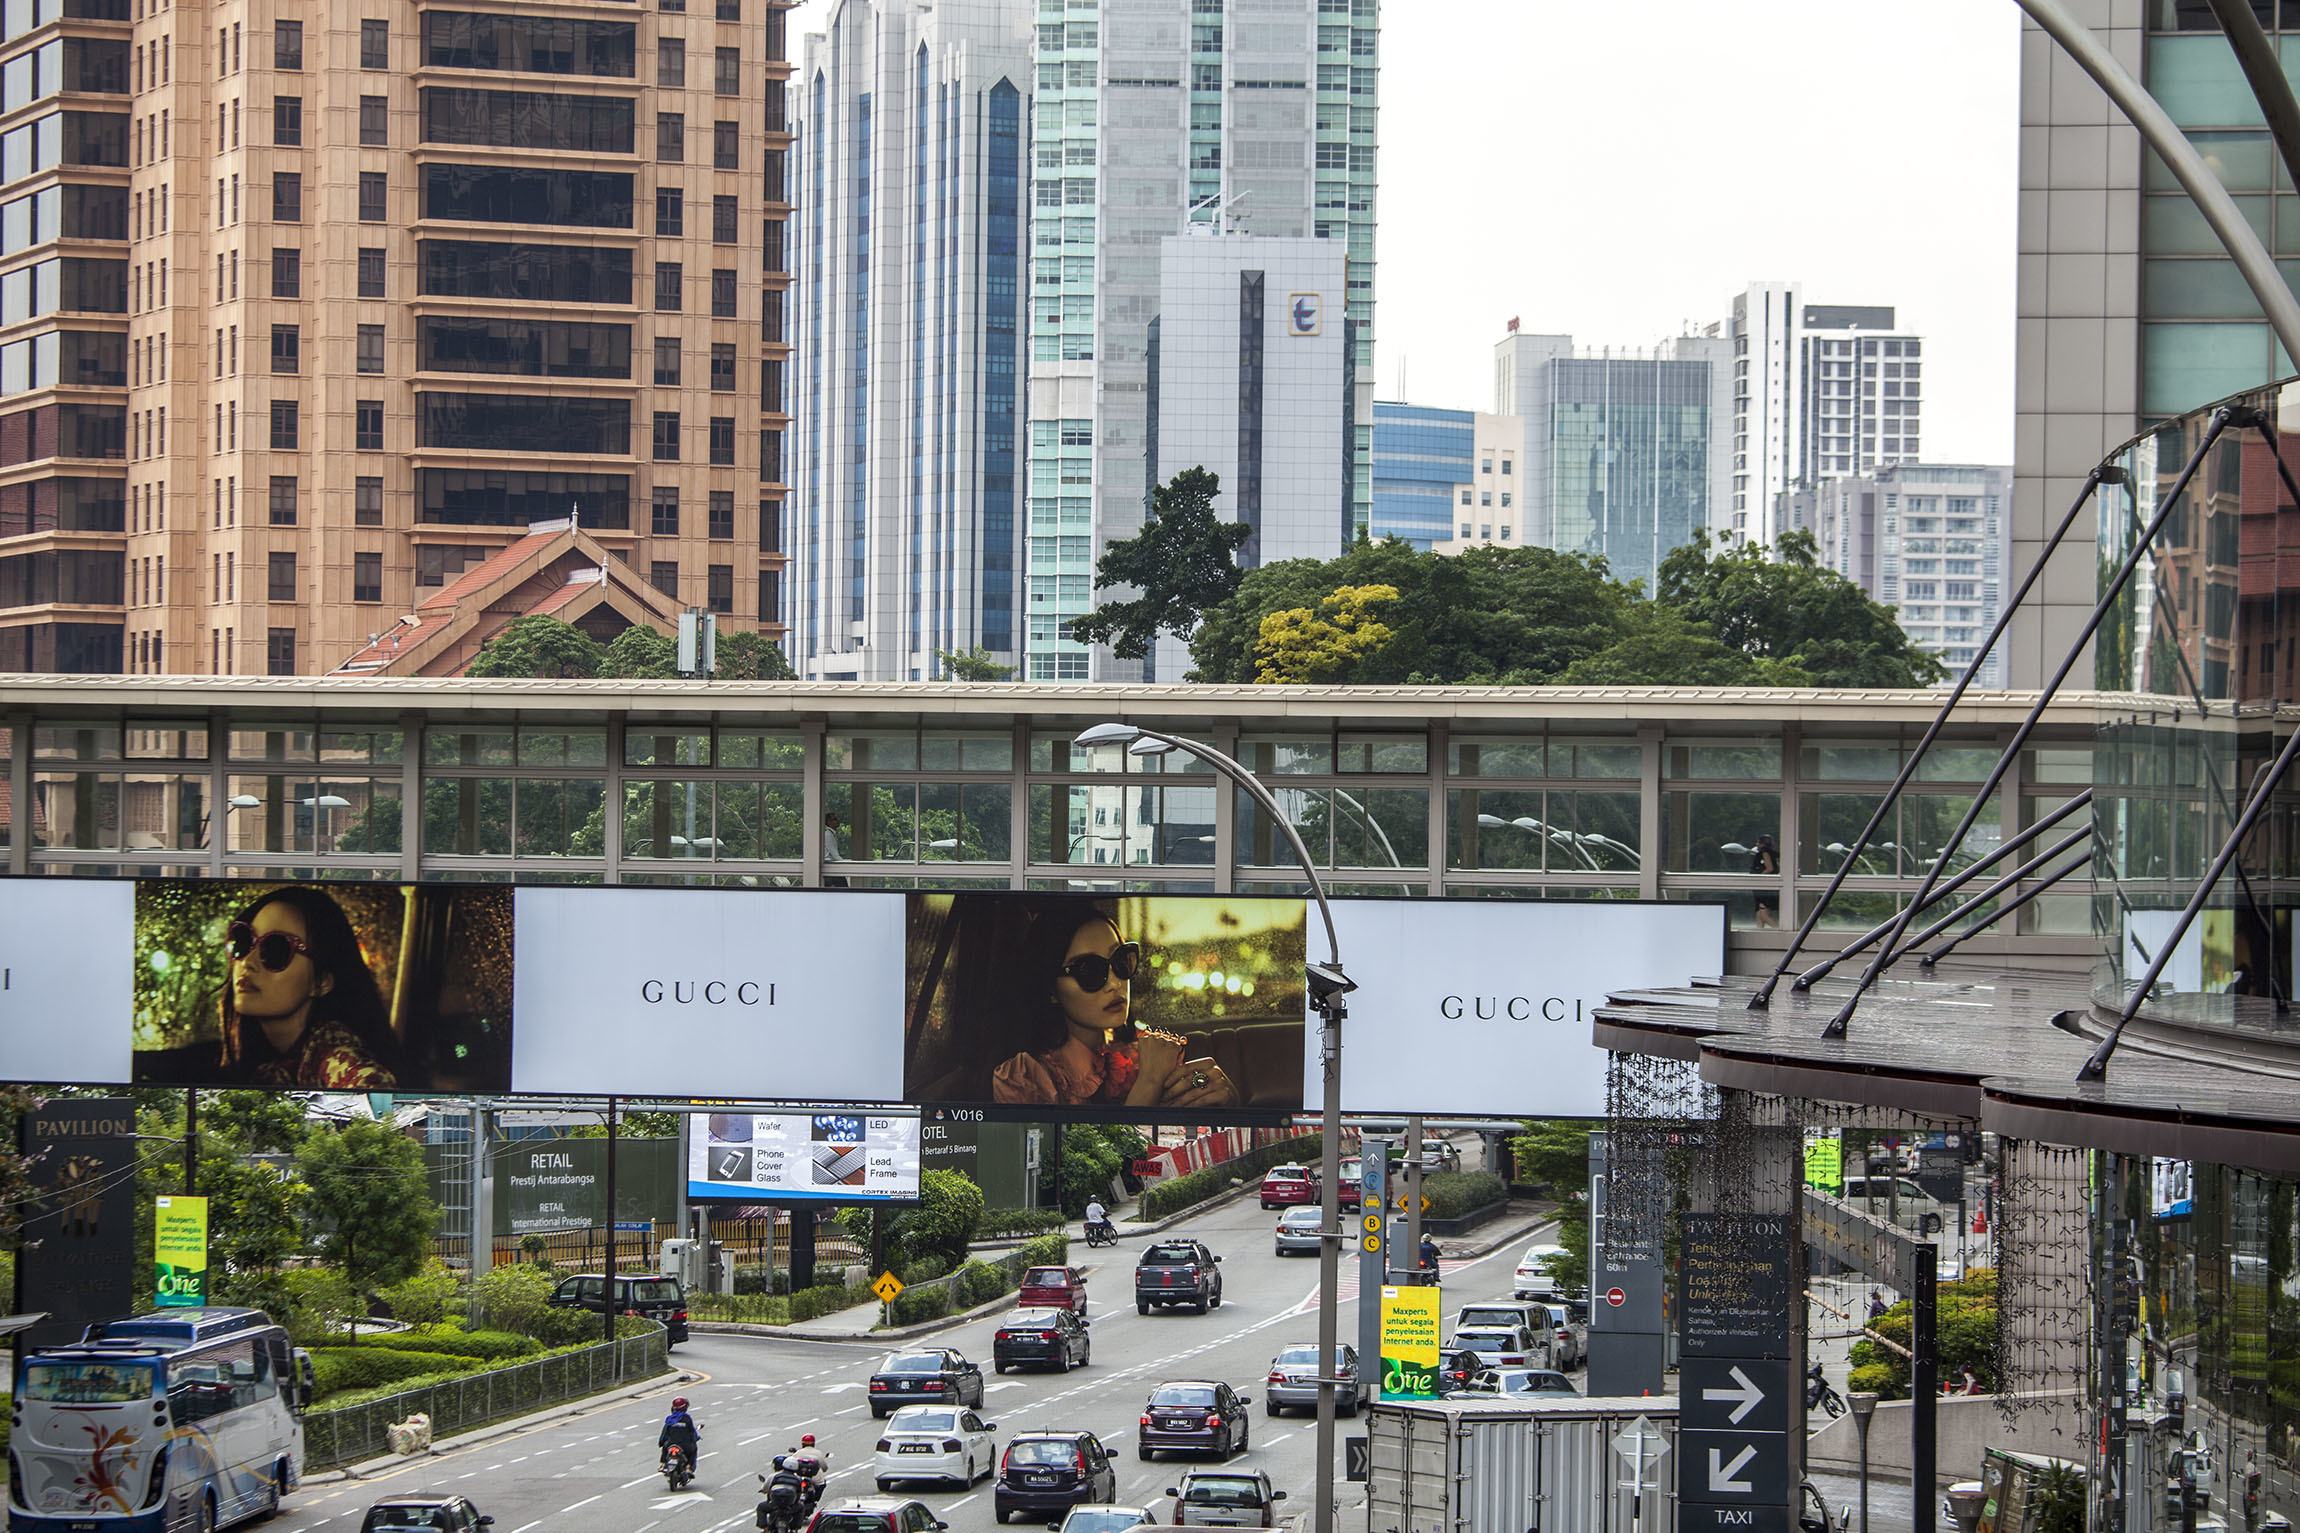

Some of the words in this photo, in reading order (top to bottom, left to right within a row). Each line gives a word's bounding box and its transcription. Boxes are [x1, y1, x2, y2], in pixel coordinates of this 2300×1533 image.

[642, 980, 775, 1005] GUCCI
[1441, 995, 1582, 1022] GUCCI
[951, 1109, 984, 1121] V016
[36, 1119, 128, 1137] PAVILION
[757, 1121, 782, 1131] Wafer
[869, 1120, 888, 1129] LED
[922, 1126, 948, 1140] OTEL
[757, 1149, 785, 1159] Phone
[925, 1145, 948, 1155] Bertaraf
[954, 1144, 977, 1154] Bintang
[531, 1153, 573, 1168] RETAIL
[756, 1161, 783, 1170] Cover
[870, 1157, 892, 1166] Lead
[1135, 1161, 1162, 1173] AWAS
[756, 1173, 781, 1183] Glass
[870, 1169, 898, 1178] Frame
[510, 1175, 536, 1188] Prestij
[537, 1174, 595, 1186] Antarabangsa
[539, 1202, 566, 1212] RETAIL
[511, 1217, 560, 1228] International
[561, 1215, 592, 1227] Prestige
[1368, 1218, 1376, 1228] B
[1368, 1238, 1376, 1248] C
[158, 1274, 200, 1297] One
[1392, 1307, 1428, 1316] Maxperts
[1410, 1318, 1434, 1327] segala
[1386, 1328, 1434, 1336] penyelesaian
[1415, 1337, 1436, 1346] anda.
[1688, 1338, 1706, 1347] Only
[1384, 1369, 1432, 1394] One
[1714, 1510, 1752, 1524] TAXI
